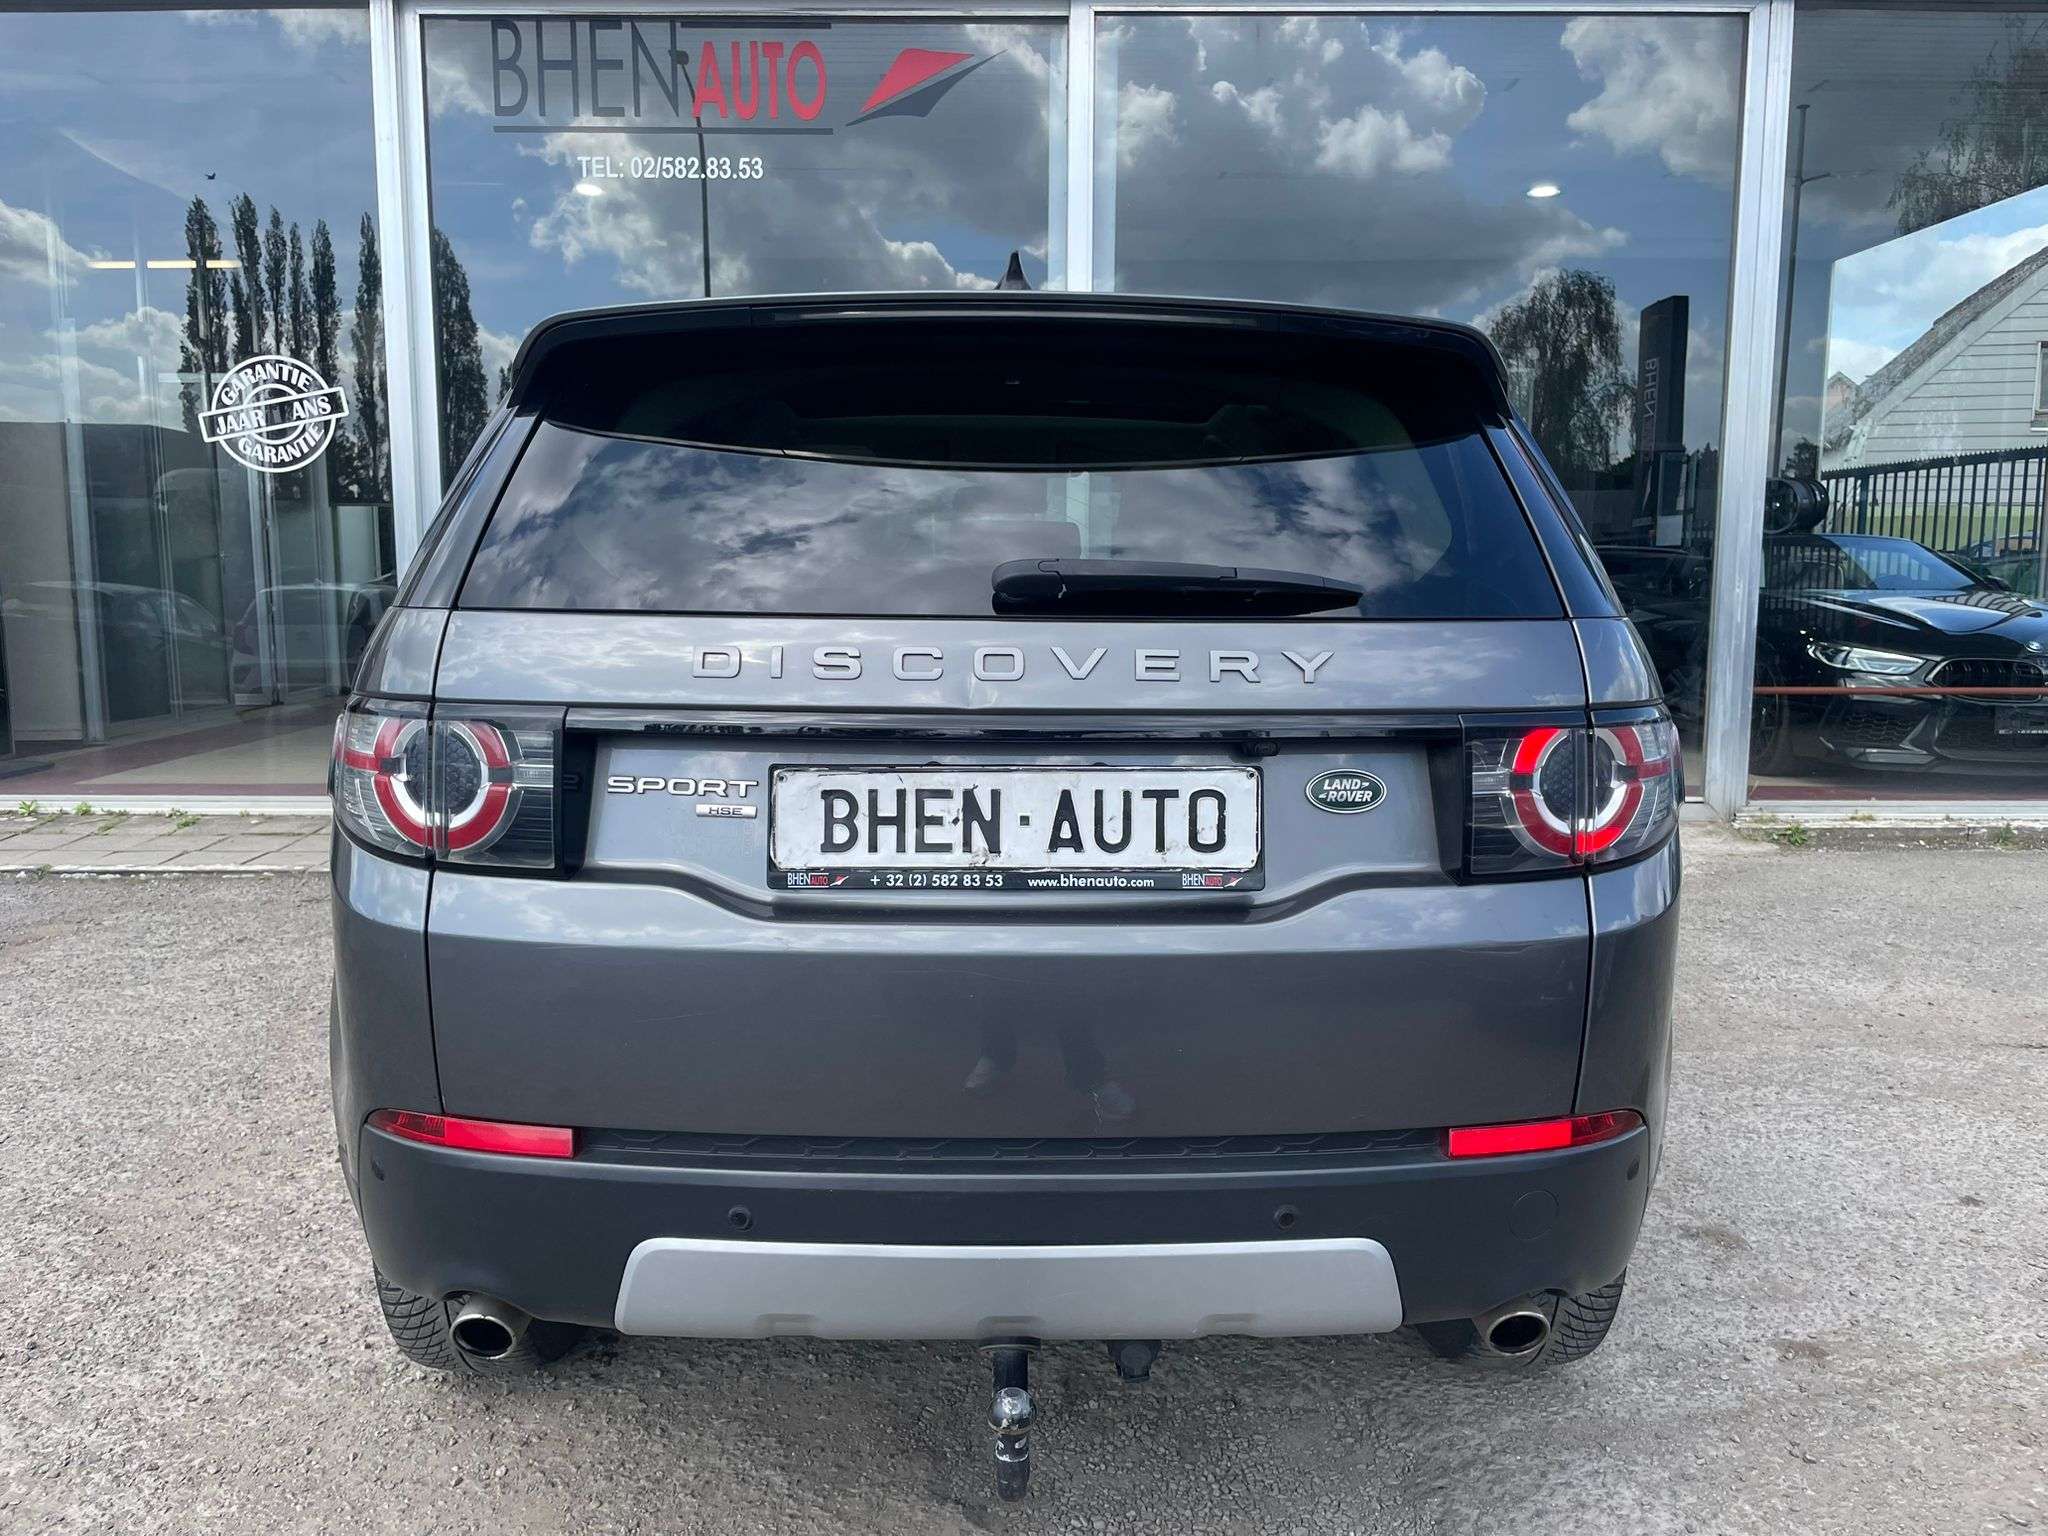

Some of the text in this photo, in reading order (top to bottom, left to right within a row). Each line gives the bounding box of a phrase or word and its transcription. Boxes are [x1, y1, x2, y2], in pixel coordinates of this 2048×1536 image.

[491, 19, 827, 120] BHEN AUTO
[577, 156, 764, 179] TEL: 02/582.83.53
[221, 363, 313, 406] GARANTIE
[216, 396, 332, 435] JAAR ANS
[238, 423, 325, 463] GARANTIE
[692, 646, 1335, 684] DISCOVERY
[607, 776, 759, 798] SPORT
[1323, 779, 1361, 790] LAND
[1326, 790, 1373, 802] ROVER
[708, 807, 743, 816] HSE
[820, 788, 1227, 854] BHEN AUTO
[886, 875, 903, 887] 32
[908, 875, 927, 887] (2)
[931, 875, 958, 887] 582
[962, 875, 981, 887] 83
[985, 875, 1003, 887] 53
[1028, 874, 1155, 888] www.bhenauto.com
